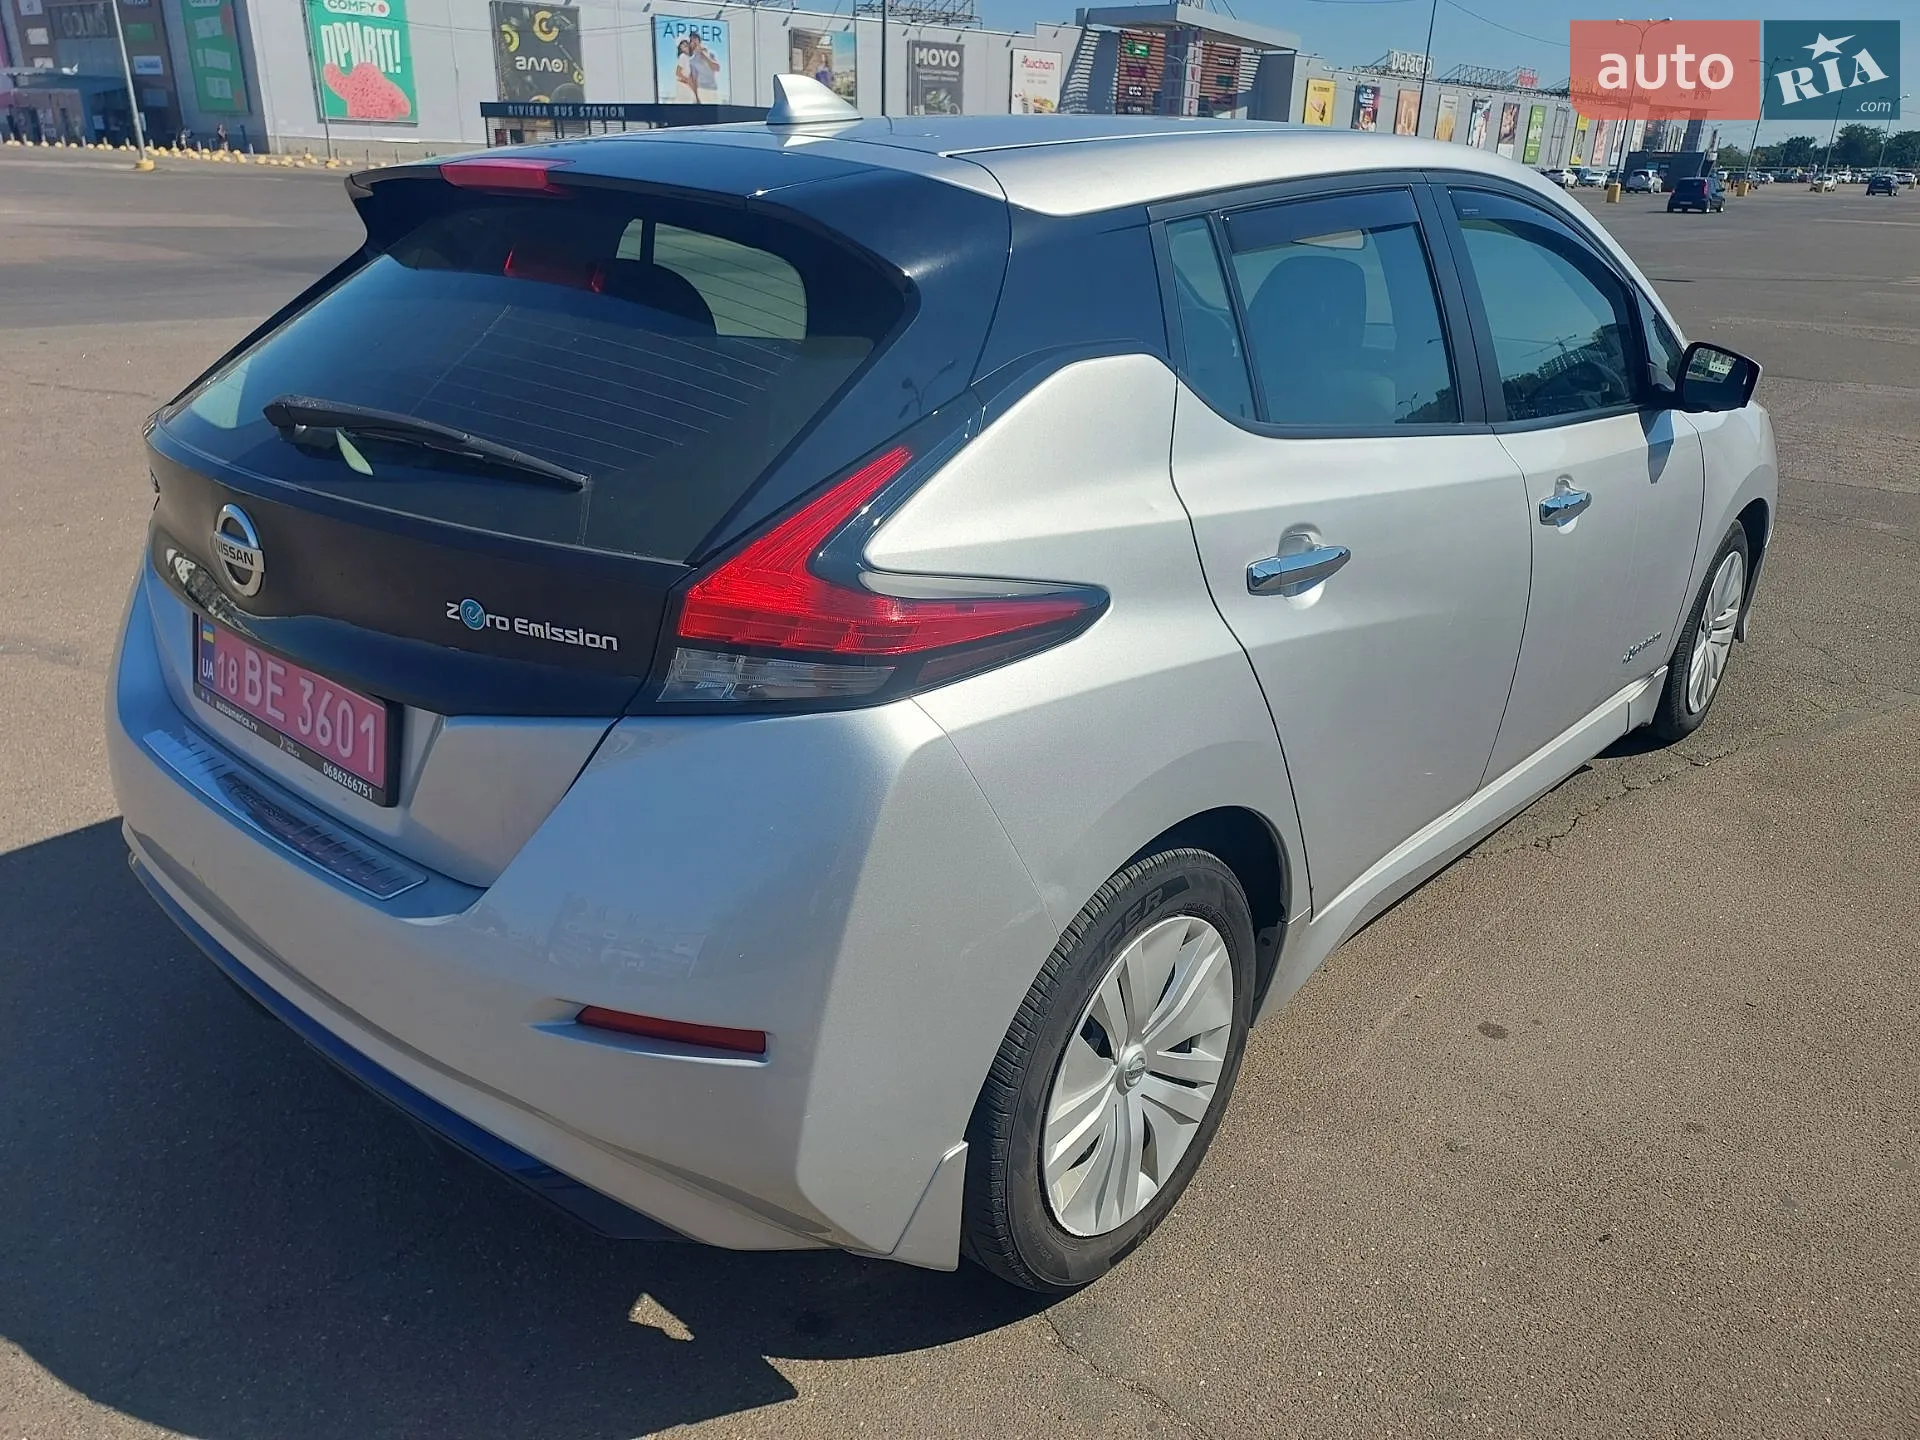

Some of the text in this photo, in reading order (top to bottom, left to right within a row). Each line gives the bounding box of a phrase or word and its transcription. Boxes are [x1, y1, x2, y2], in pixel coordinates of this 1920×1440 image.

[914, 47, 960, 68] MOYO
[508, 105, 625, 118] RIVIERA BUS STATION
[215, 538, 255, 566] NISSAN
[513, 616, 618, 651] Emission
[202, 657, 214, 681] UA
[217, 651, 238, 696] 18
[298, 675, 376, 774] 3601
[323, 762, 373, 800] 0686266751
